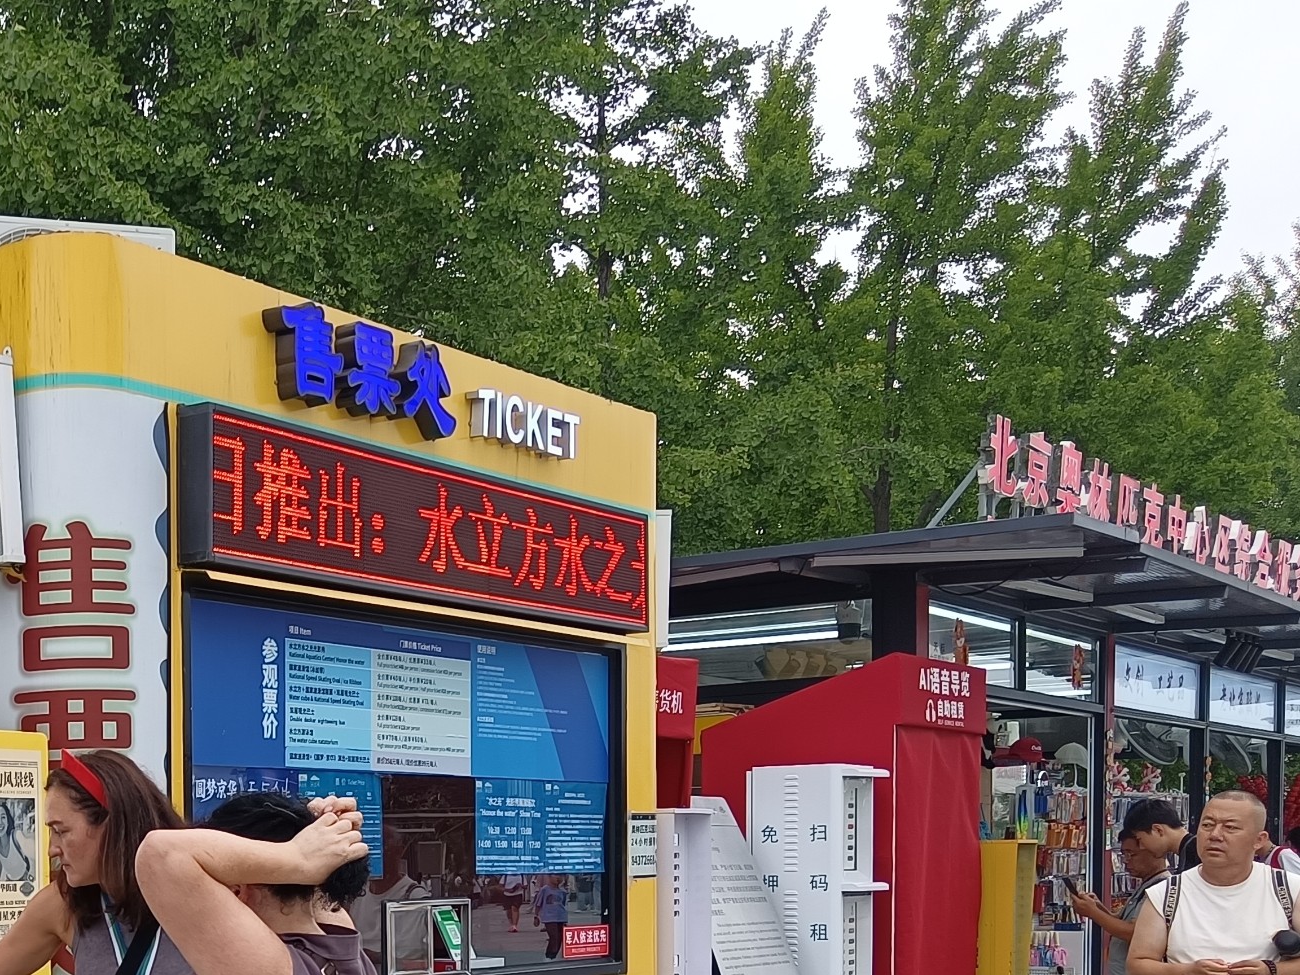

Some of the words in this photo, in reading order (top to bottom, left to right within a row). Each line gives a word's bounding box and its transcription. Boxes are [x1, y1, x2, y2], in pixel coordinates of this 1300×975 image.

[280, 302, 457, 440] 售票处
[476, 388, 581, 460] TICKET
[261, 637, 280, 740] 参观票价
[919, 667, 971, 697] AI语音导览
[937, 699, 965, 719] 自助租赁
[809, 823, 829, 942] 扫码租
[565, 929, 607, 945] 军人依法优先
